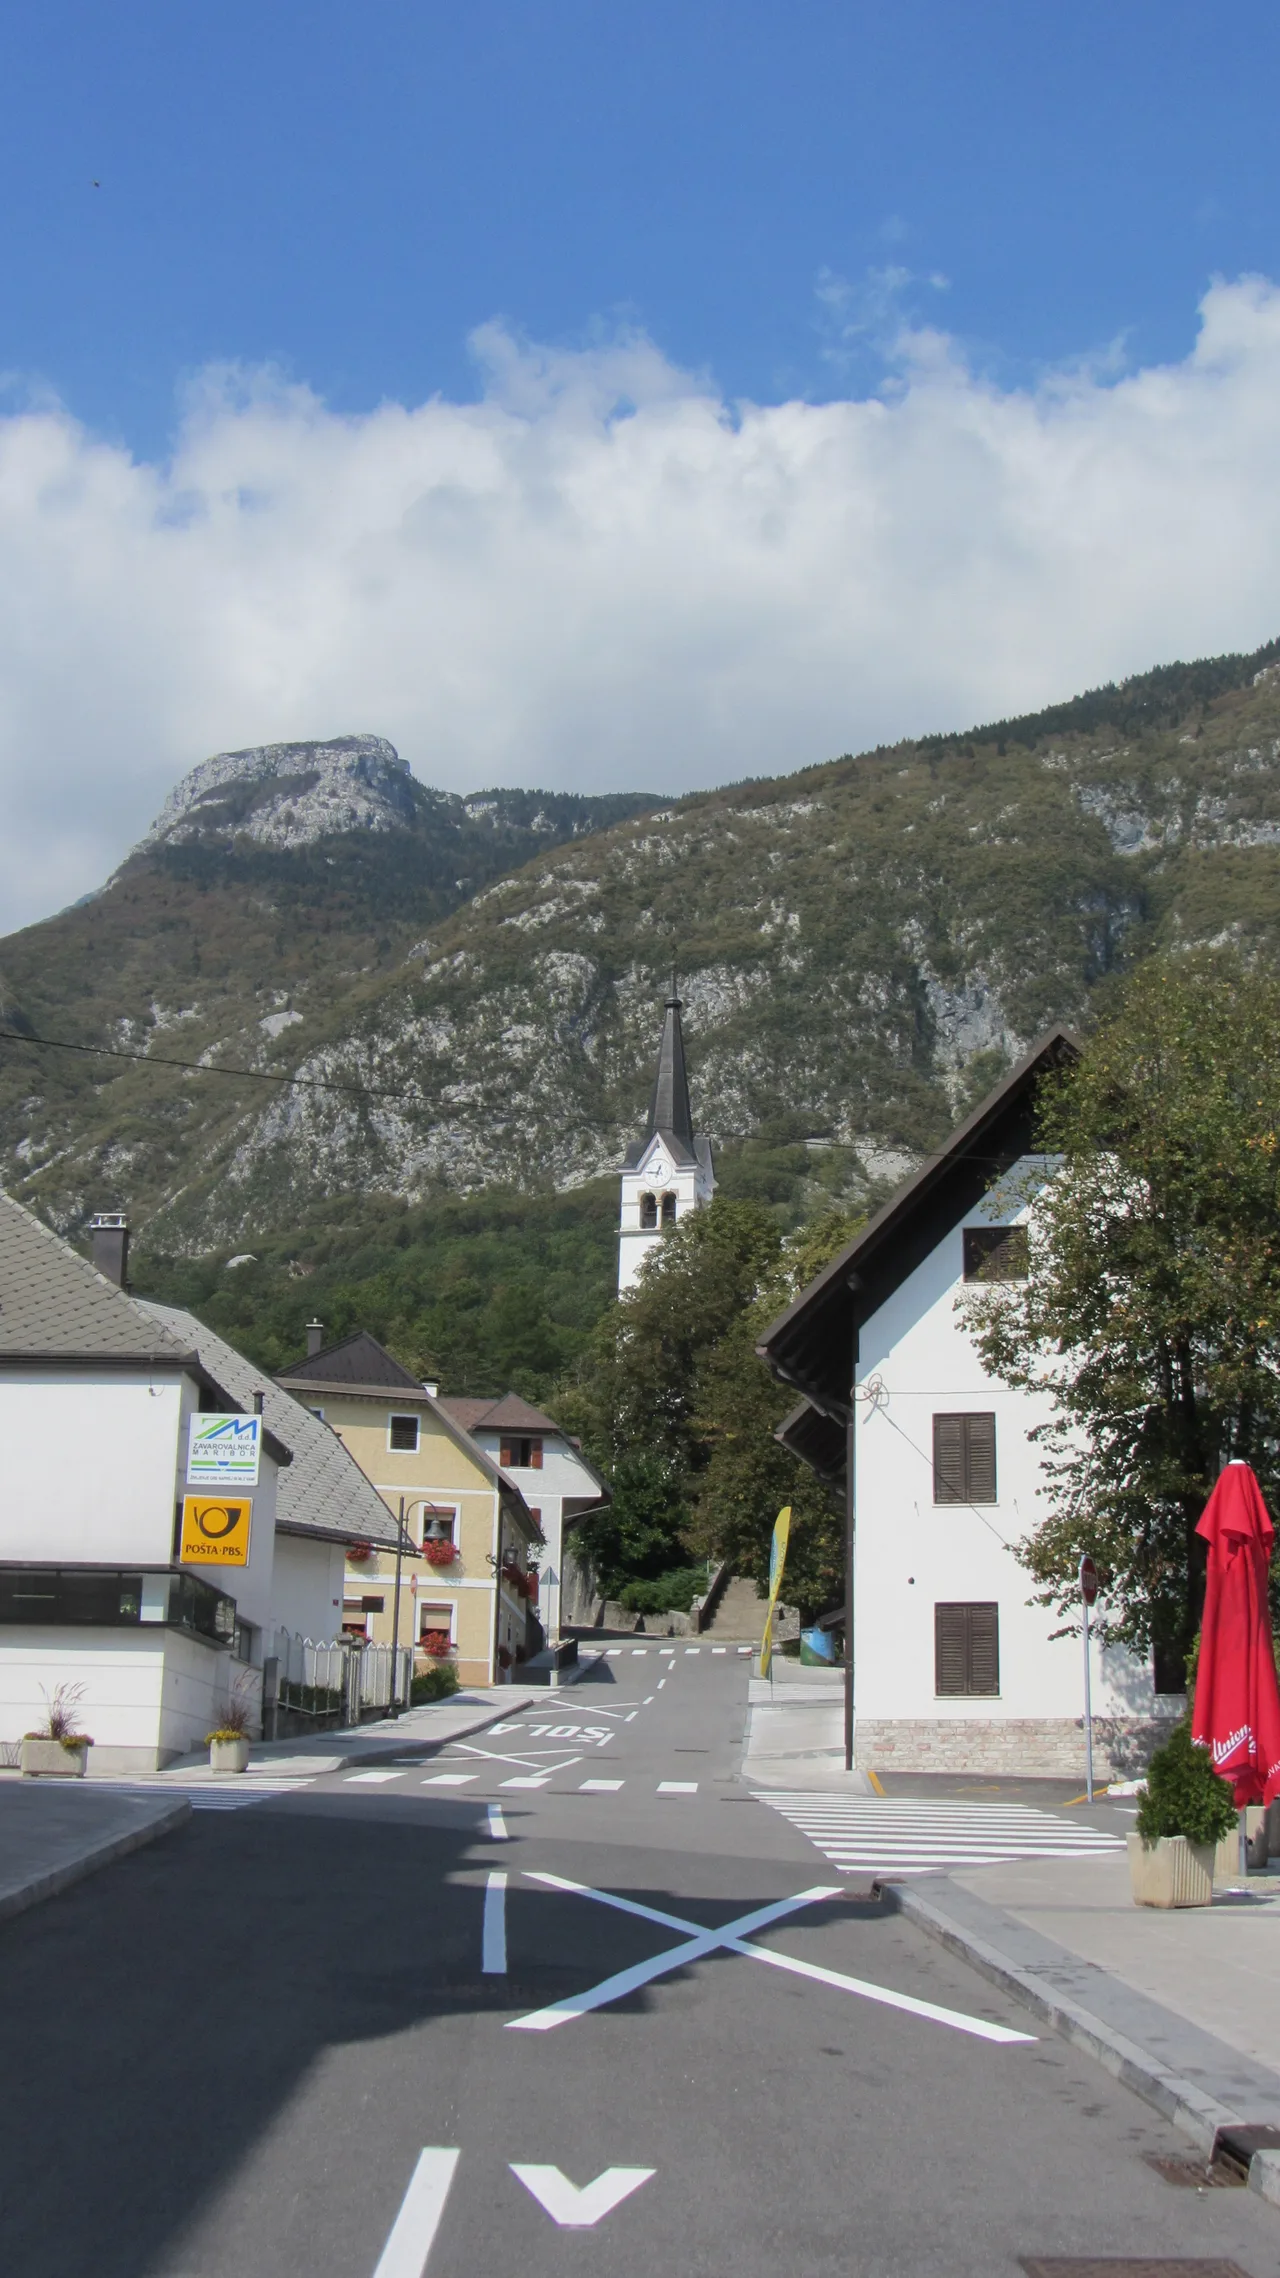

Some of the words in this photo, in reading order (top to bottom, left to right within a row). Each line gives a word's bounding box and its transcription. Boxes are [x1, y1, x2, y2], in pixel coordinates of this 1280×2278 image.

[195, 1418, 257, 1441] ZM
[192, 1449, 256, 1457] MARIBOR
[193, 1443, 256, 1451] ZAVAROVALNICA
[186, 1542, 218, 1555] POŠTA
[222, 1546, 243, 1557] PBS.
[487, 1723, 610, 1743] ŠOLA
[1213, 1724, 1251, 1762] Union
